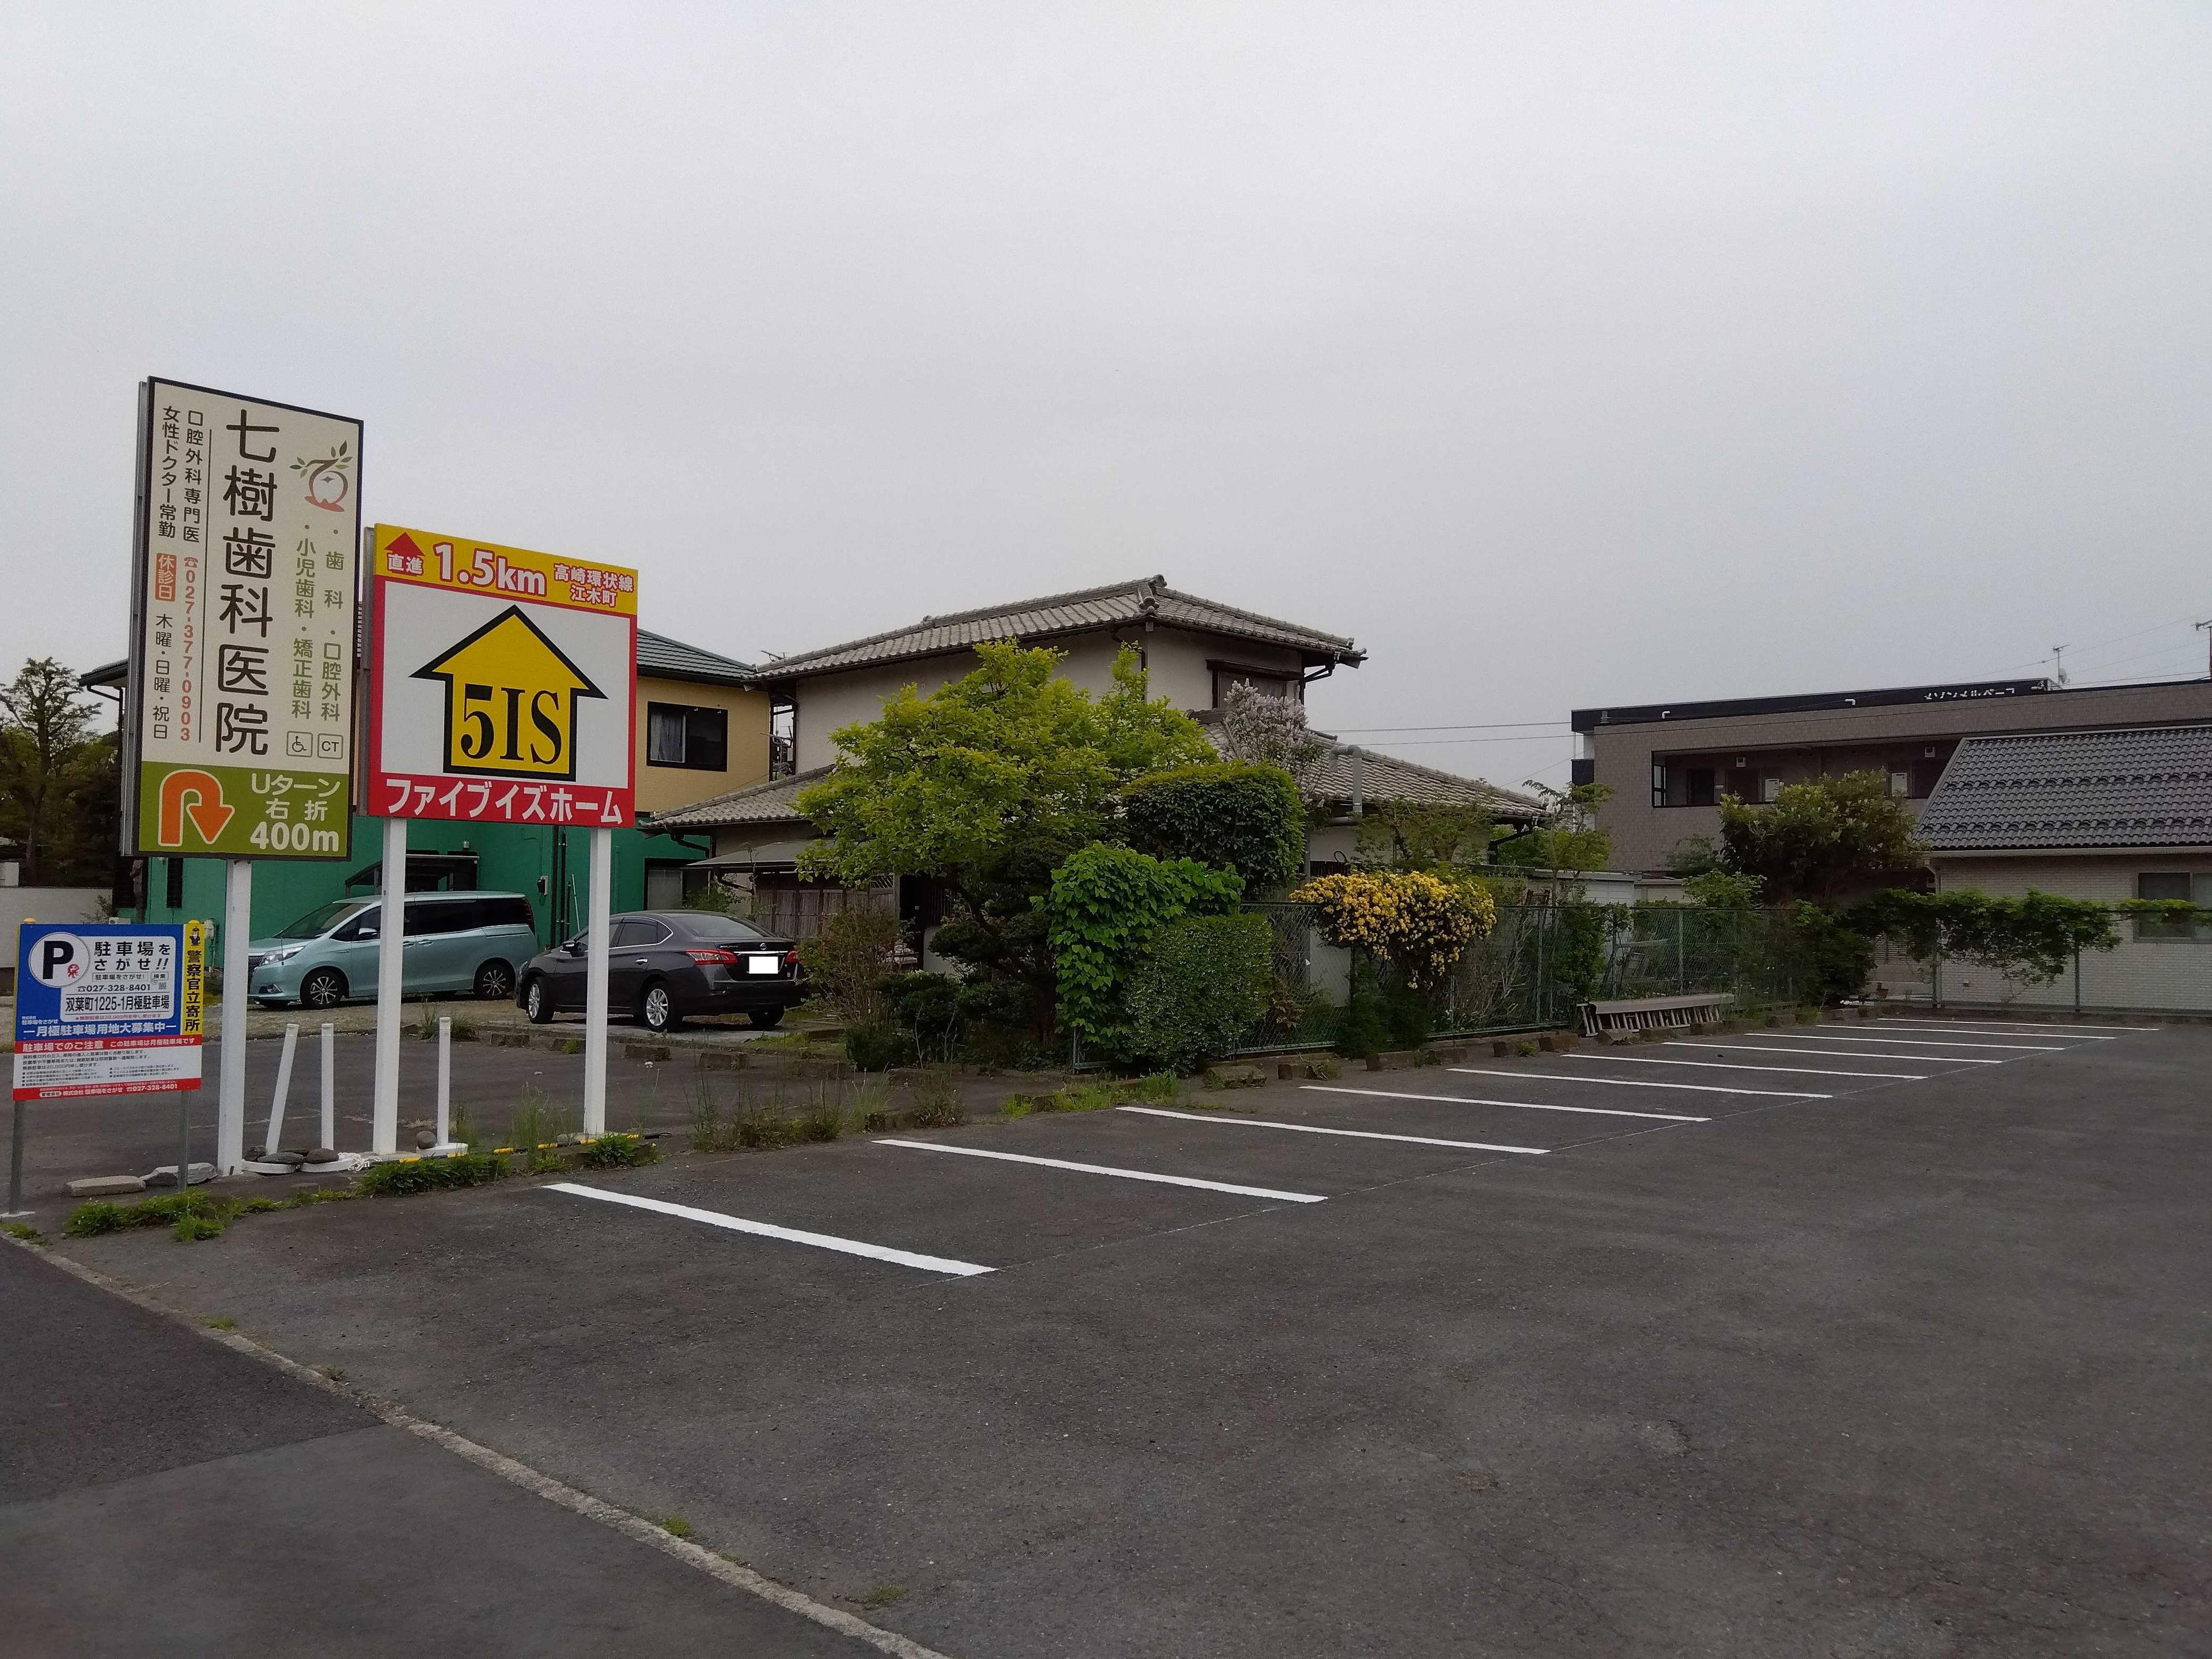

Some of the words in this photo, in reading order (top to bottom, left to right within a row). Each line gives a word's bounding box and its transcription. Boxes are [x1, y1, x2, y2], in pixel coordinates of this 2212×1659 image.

[158, 406, 180, 539] 女性ドクター常勤
[183, 410, 203, 543] 口腔外科専門医
[157, 555, 175, 600] 休診日
[387, 553, 424, 574] 直進
[433, 541, 547, 597] 1.5km
[554, 563, 634, 593] 高崎環状線
[215, 409, 280, 756] 七樹歯科医院
[570, 585, 617, 607] 江木町
[460, 683, 563, 766] 5IS
[321, 740, 339, 752] CT
[251, 773, 341, 798] Uターン
[385, 778, 623, 825] ファイブイズホーム
[250, 821, 339, 851] 400m
[42, 940, 74, 980] P
[94, 941, 171, 957] 駐車場を
[86, 984, 151, 992] 027-328-8401
[185, 950, 202, 1032] 警察官立寄所
[66, 995, 169, 1012] 双葉町1225-1月極駐車場
[22, 1040, 104, 1052] 駐車場でのご注意
